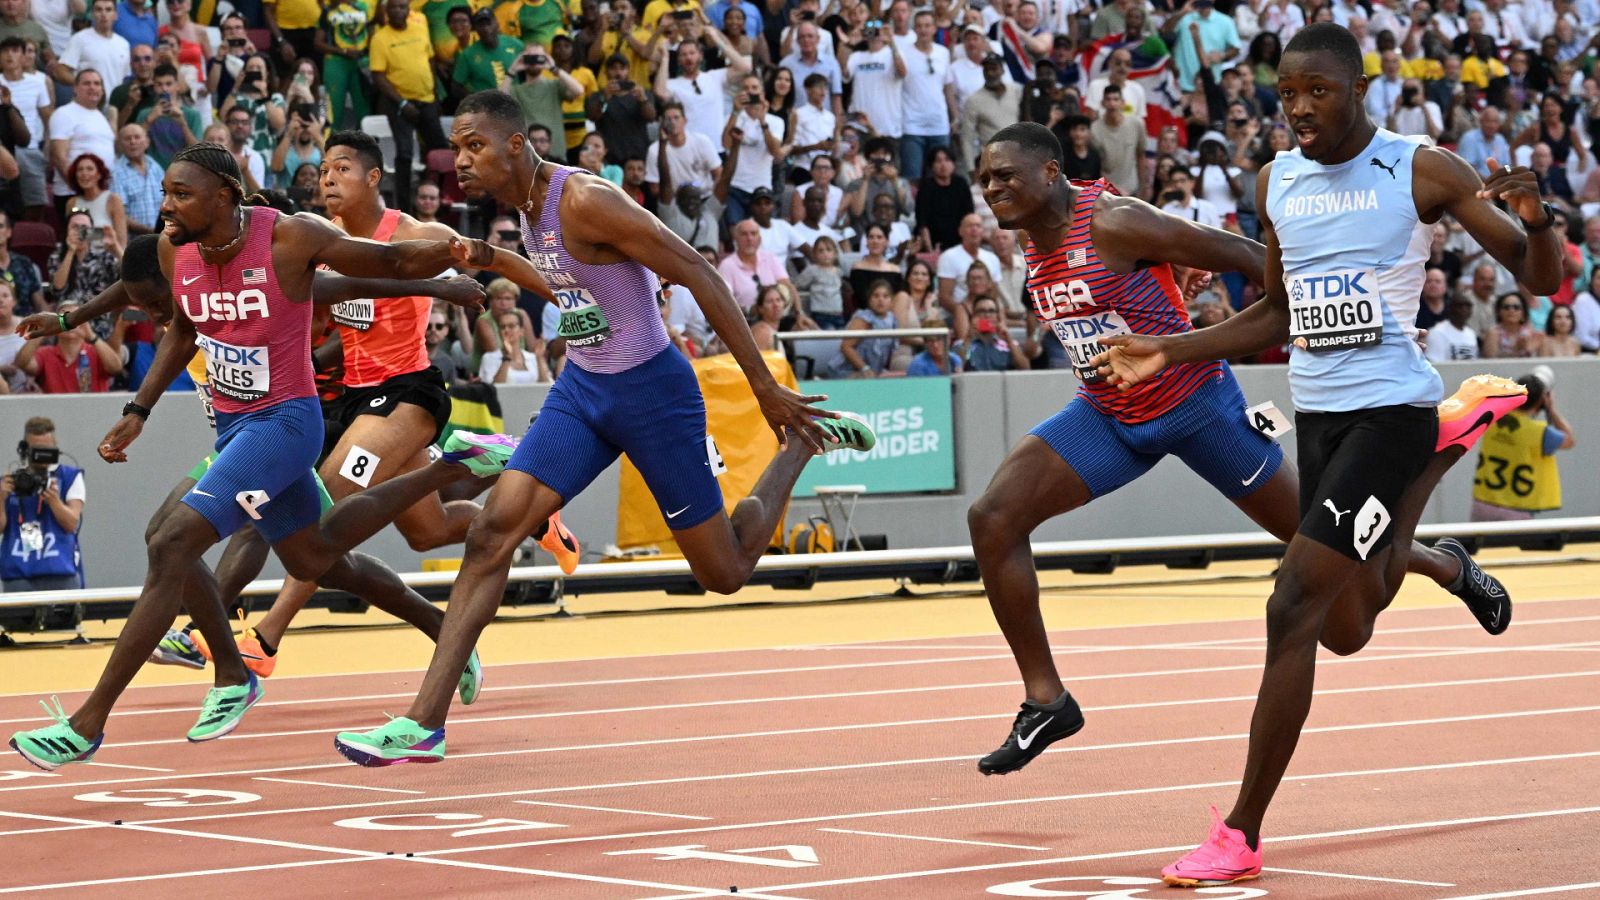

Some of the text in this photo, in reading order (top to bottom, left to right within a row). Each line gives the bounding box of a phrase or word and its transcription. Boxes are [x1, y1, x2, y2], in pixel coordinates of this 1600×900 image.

[1284, 189, 1379, 217] BOTSWANA
[1303, 272, 1369, 300] TDK
[180, 288, 270, 323] USA
[554, 289, 591, 310] DK
[1033, 280, 1097, 320] USA
[1064, 313, 1119, 339] TDK
[1293, 300, 1374, 331] TEBOGO
[208, 340, 263, 366] TDK
[1309, 332, 1377, 348] BUDAPEST 23
[212, 362, 254, 388] YLES
[216, 383, 254, 401] BUDAPEST
[865, 406, 924, 434] NESS
[1254, 411, 1276, 432] 4
[351, 455, 369, 478] 8
[1358, 511, 1382, 545] 3
